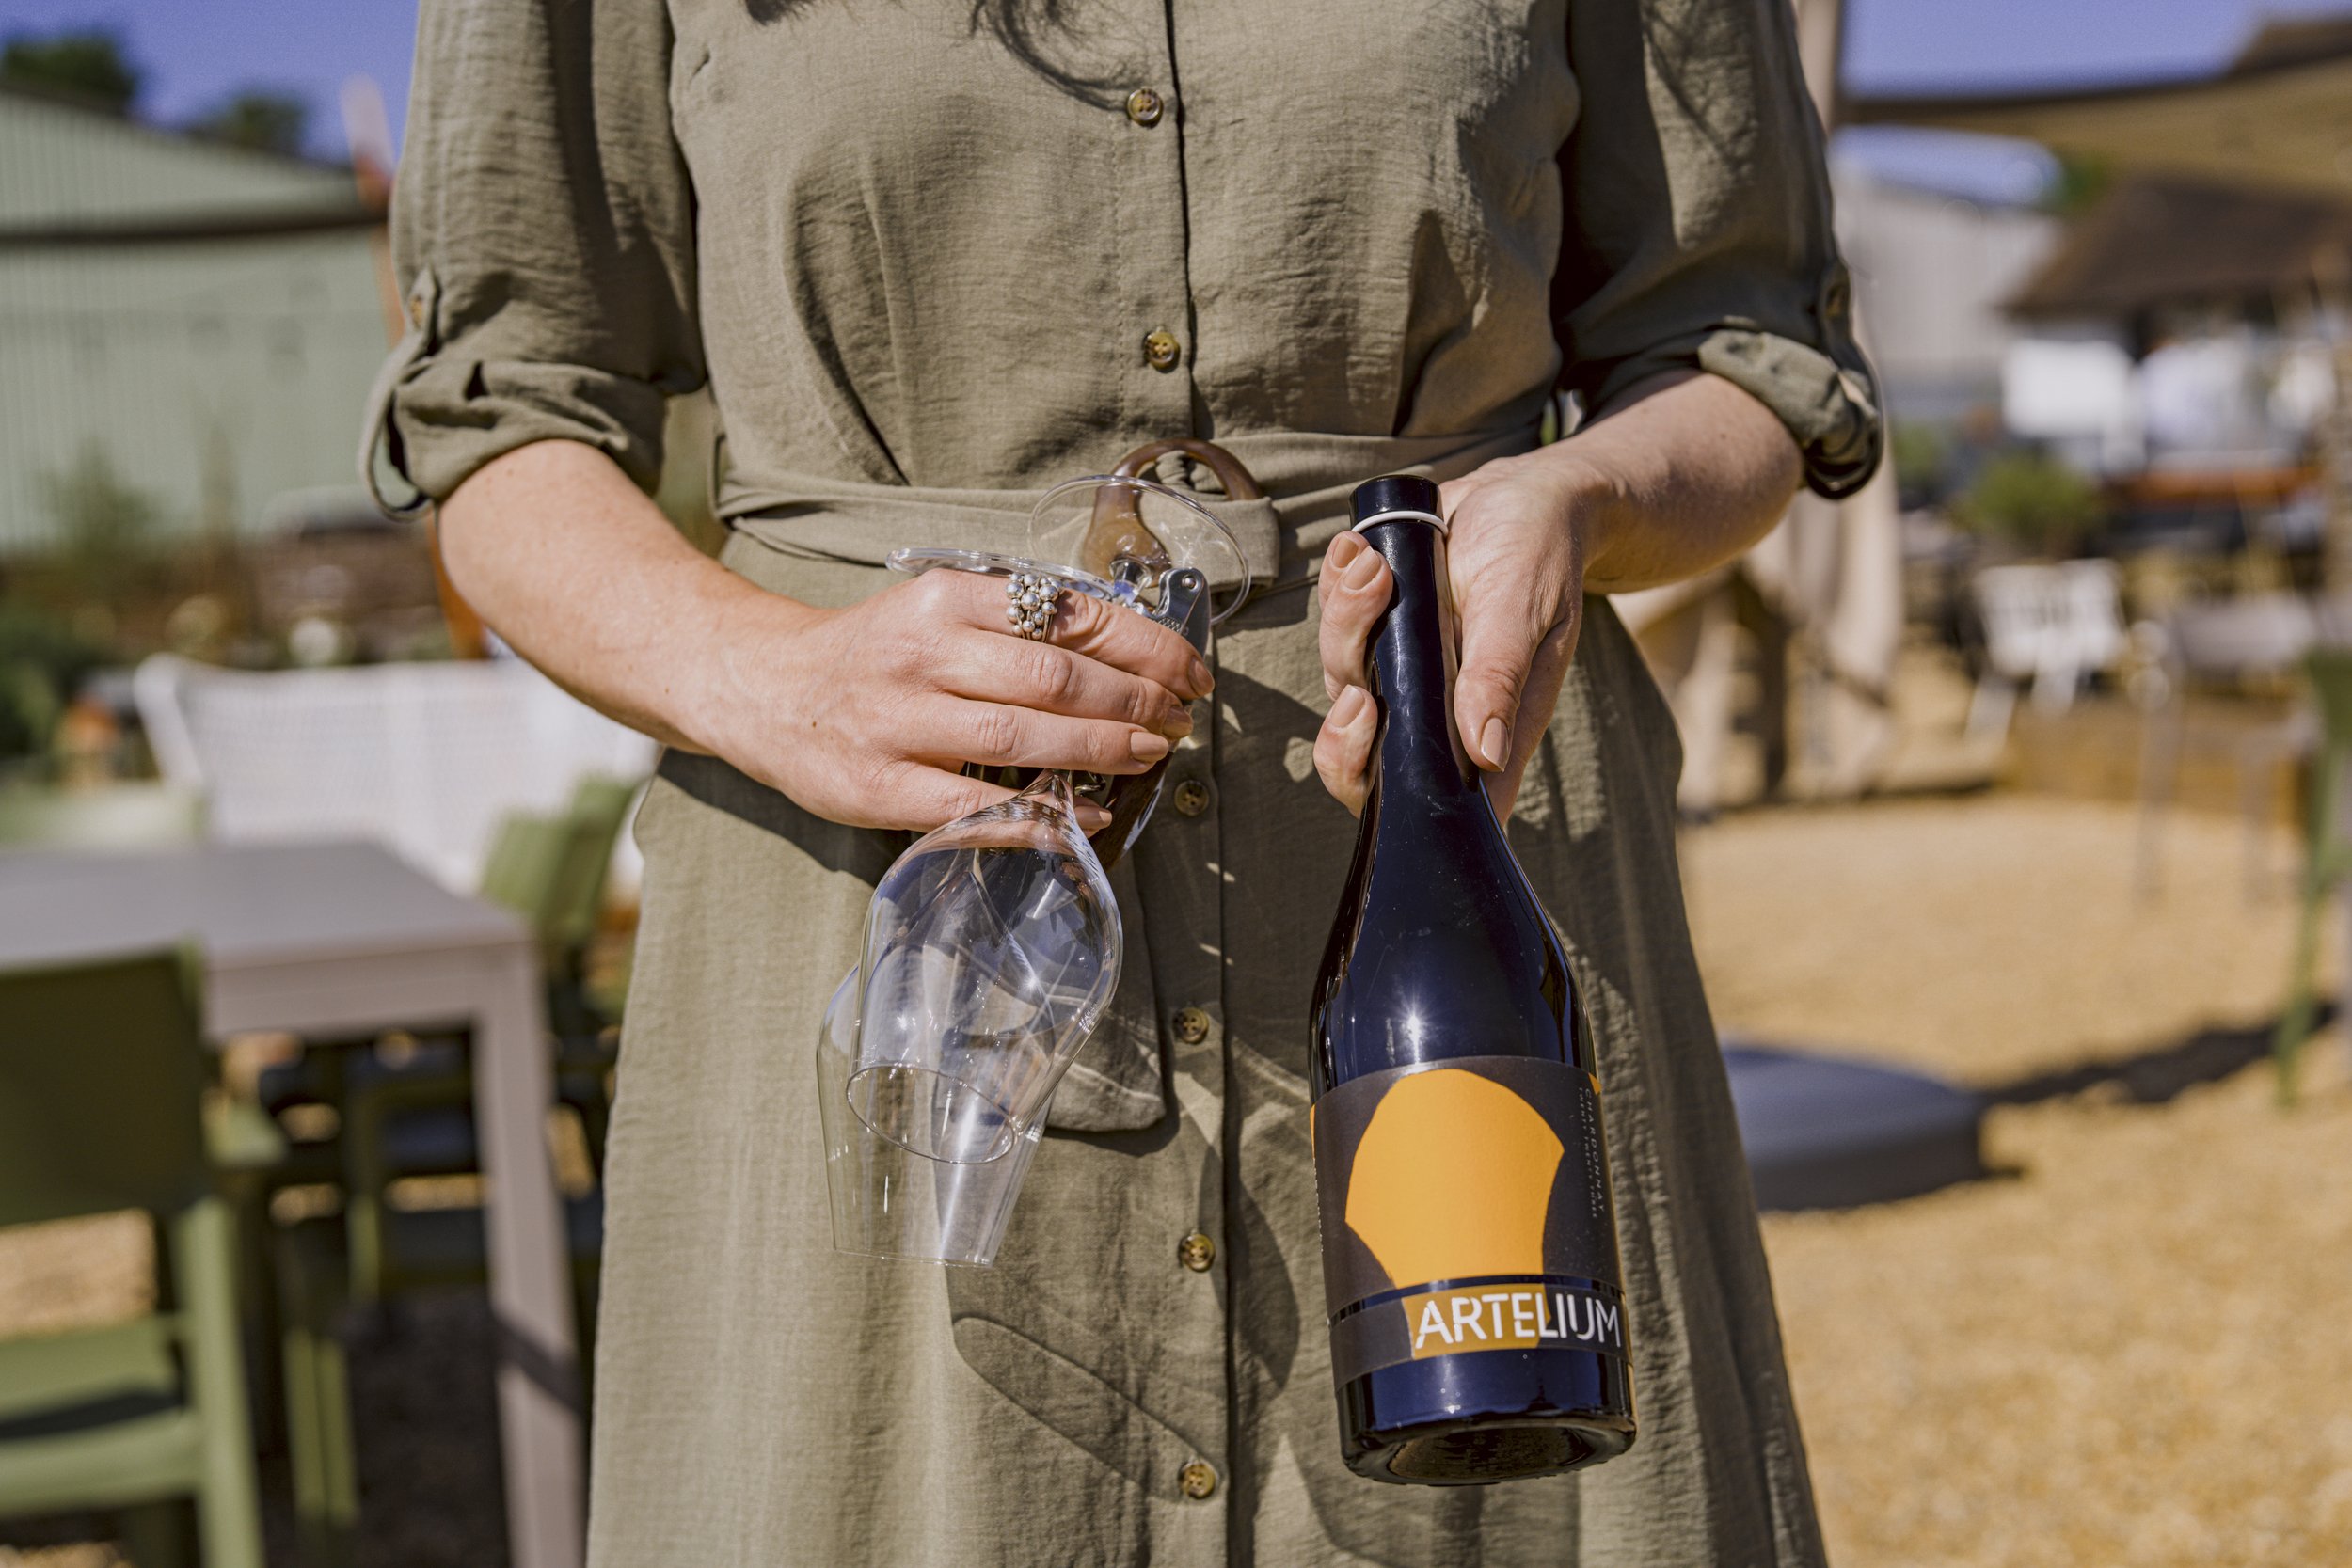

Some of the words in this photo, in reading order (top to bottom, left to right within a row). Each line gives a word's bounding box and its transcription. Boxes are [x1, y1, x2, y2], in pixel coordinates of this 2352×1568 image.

[1579, 1087, 1587, 1130] TWENTY
[1583, 1136, 1592, 1179] TWENTY
[1589, 1186, 1597, 1218] THREE
[1585, 1088, 1605, 1212] CHARDONNAY
[1415, 1293, 1621, 1349] ARTELIUM
